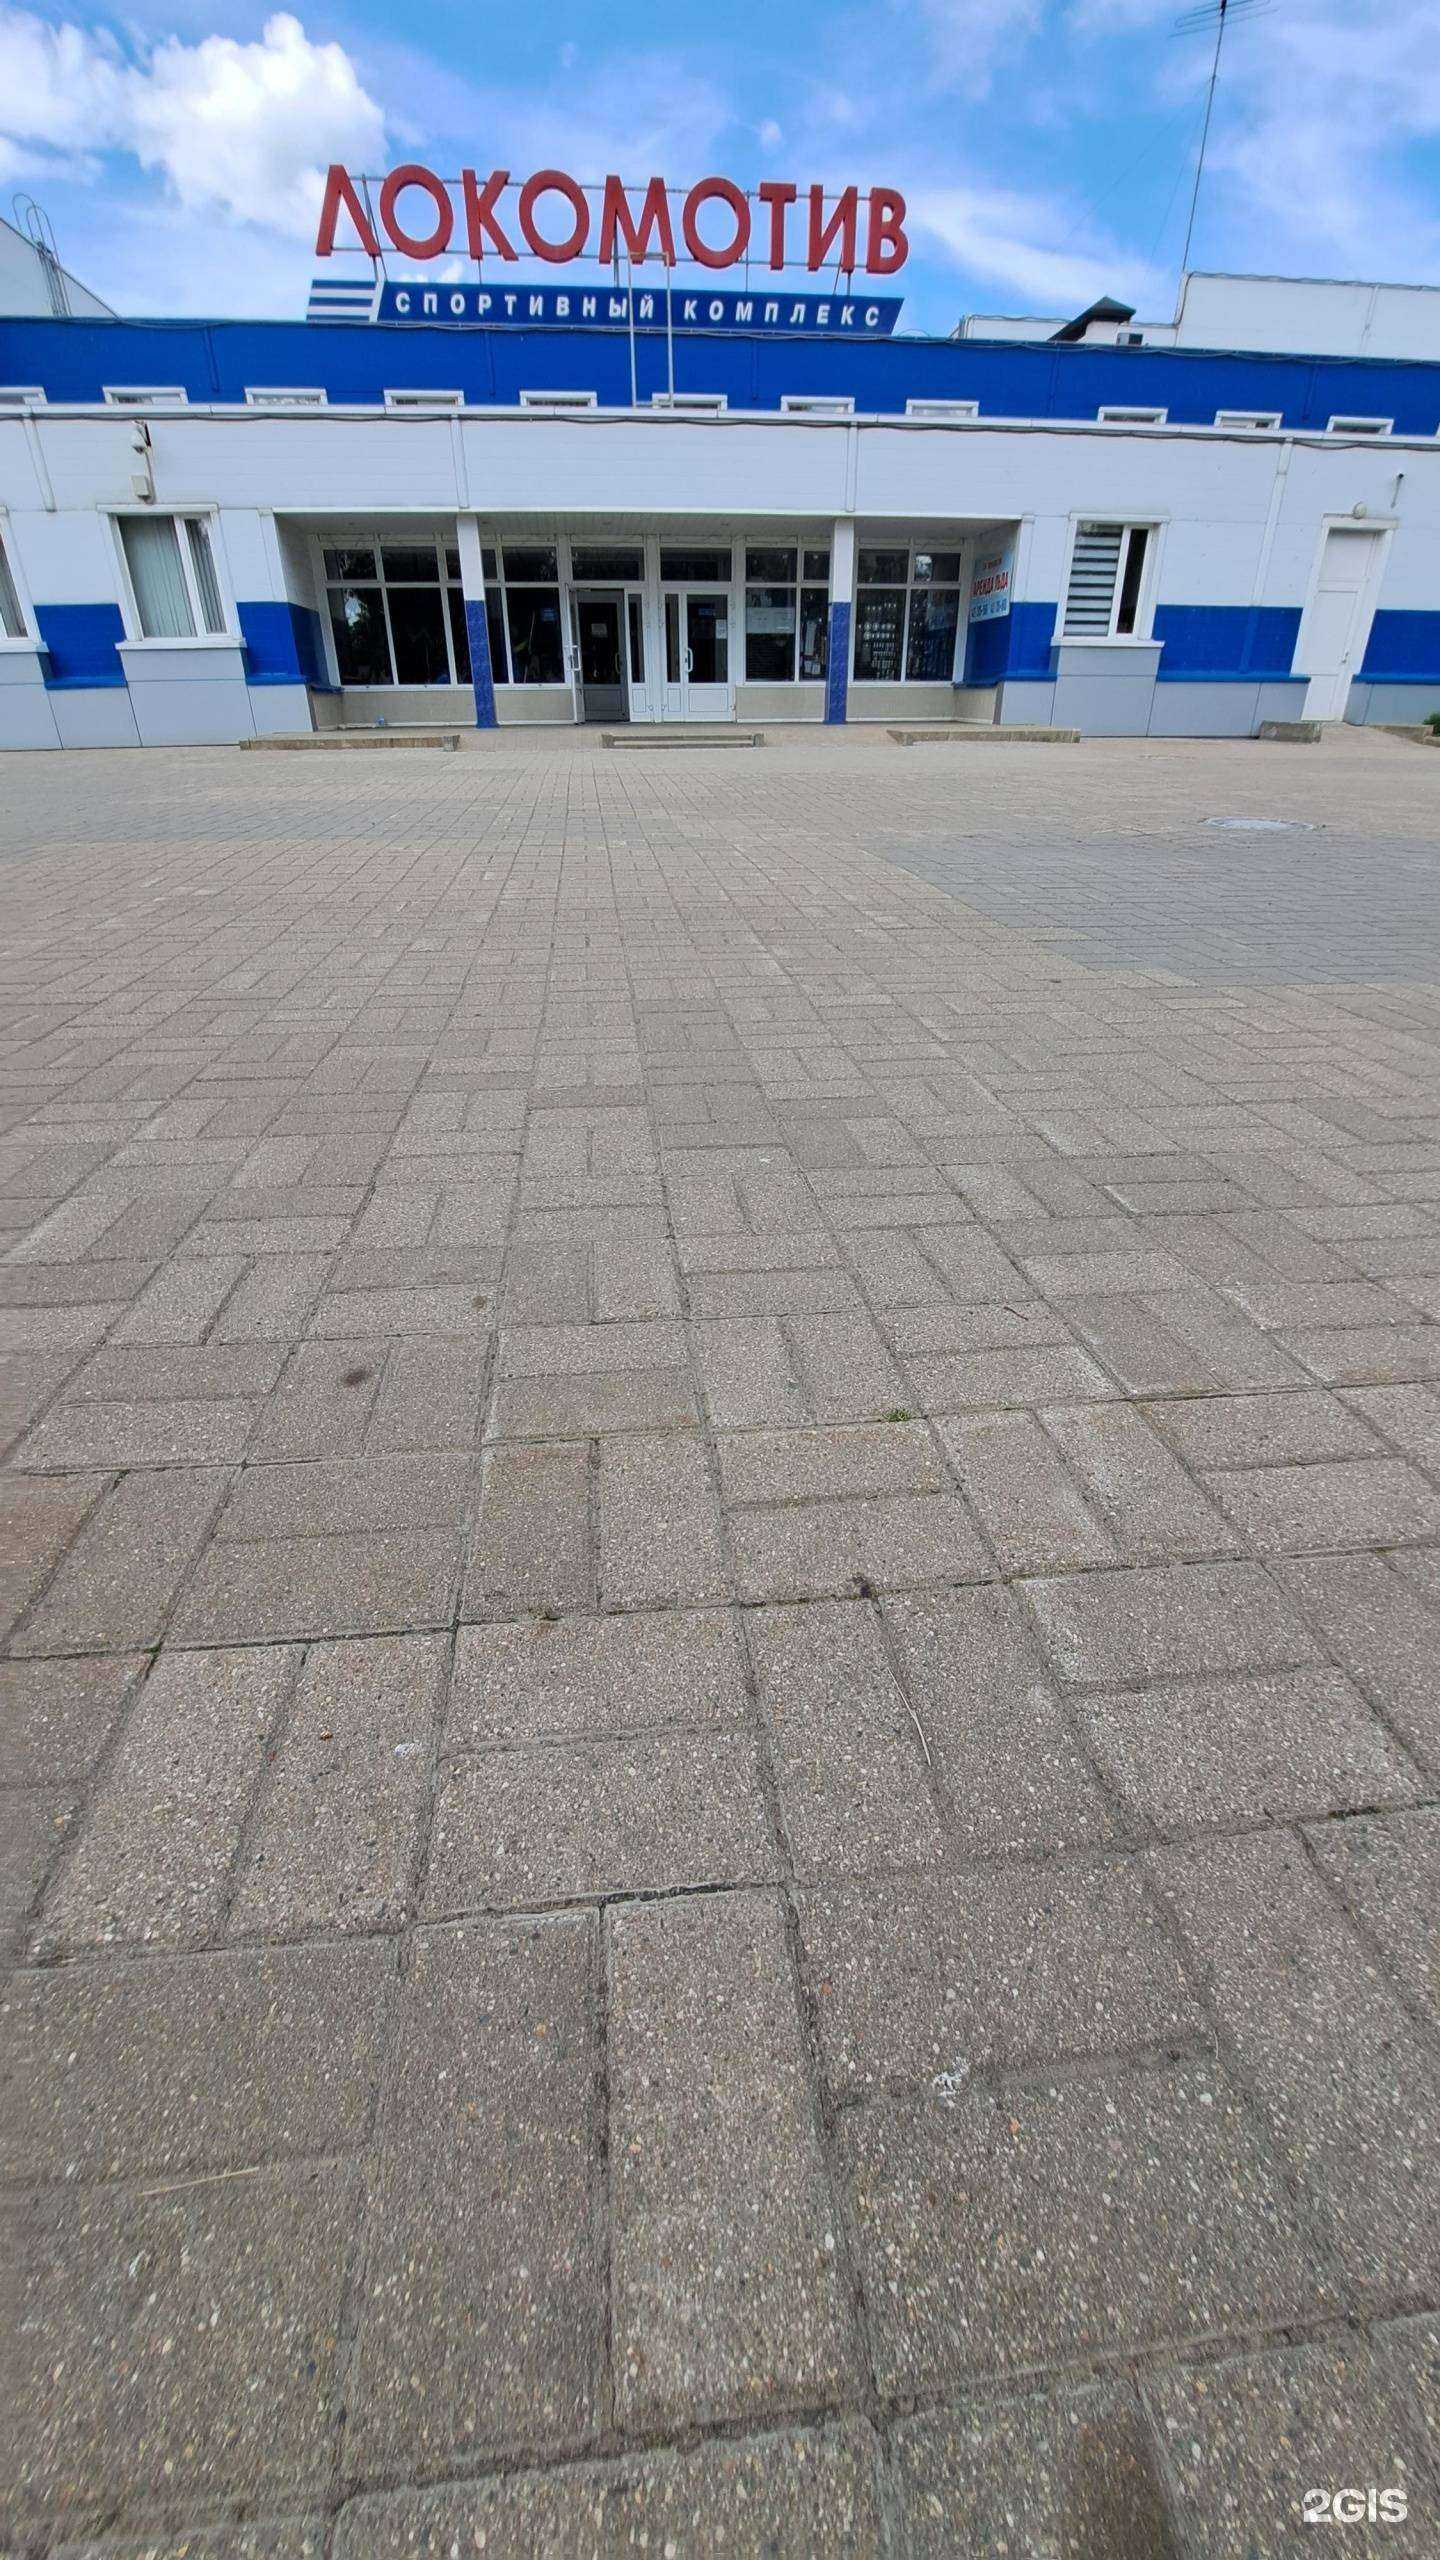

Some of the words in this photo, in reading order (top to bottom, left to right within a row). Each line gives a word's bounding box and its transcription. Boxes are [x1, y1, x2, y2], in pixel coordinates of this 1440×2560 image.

[315, 164, 909, 274] ЛОКОМОТИВ
[395, 292, 655, 319] СПОРТИВНЫЙ
[683, 299, 880, 326] КОМПЛЕКС
